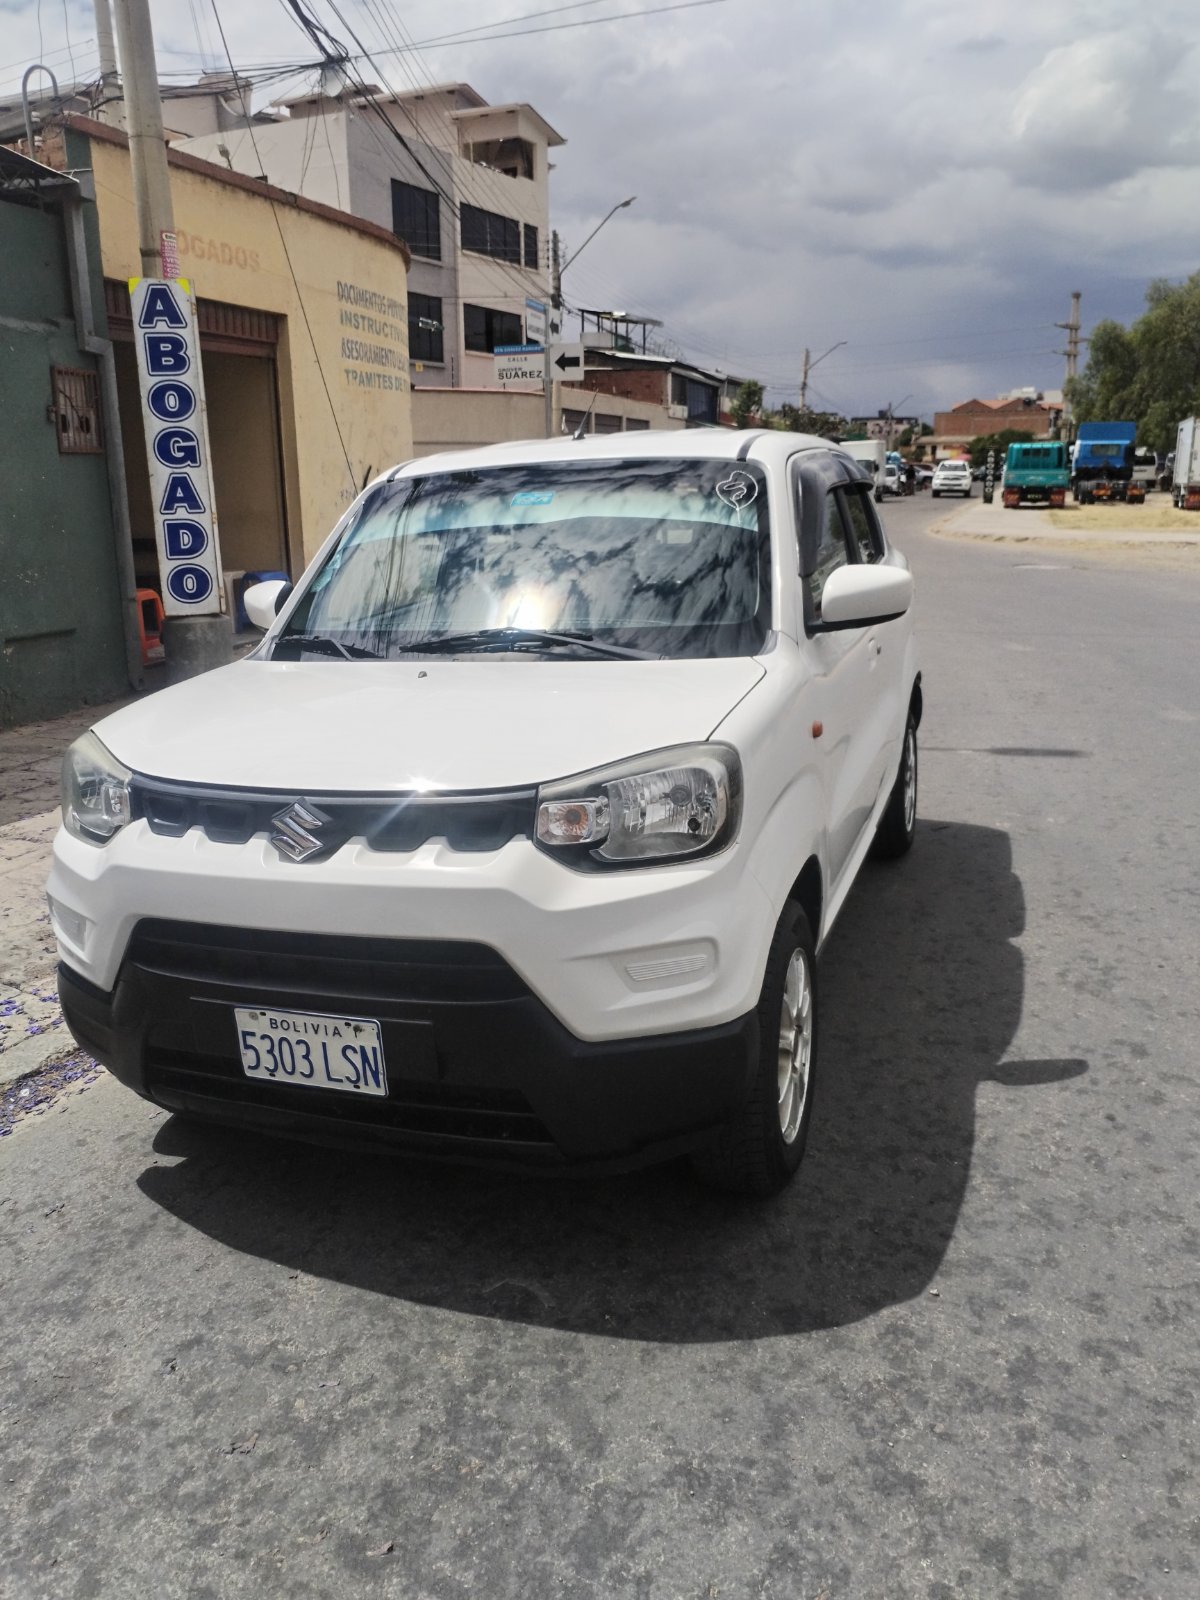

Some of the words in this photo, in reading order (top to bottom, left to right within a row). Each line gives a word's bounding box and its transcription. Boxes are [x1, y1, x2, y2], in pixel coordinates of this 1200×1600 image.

[337, 280, 386, 316] DOCUMENTOS
[344, 368, 393, 390] TRAMITES
[138, 283, 213, 604] ABOGADO
[269, 1017, 343, 1038] BOLIVIA
[241, 1029, 315, 1079] 5303
[321, 1041, 381, 1089] LSN
